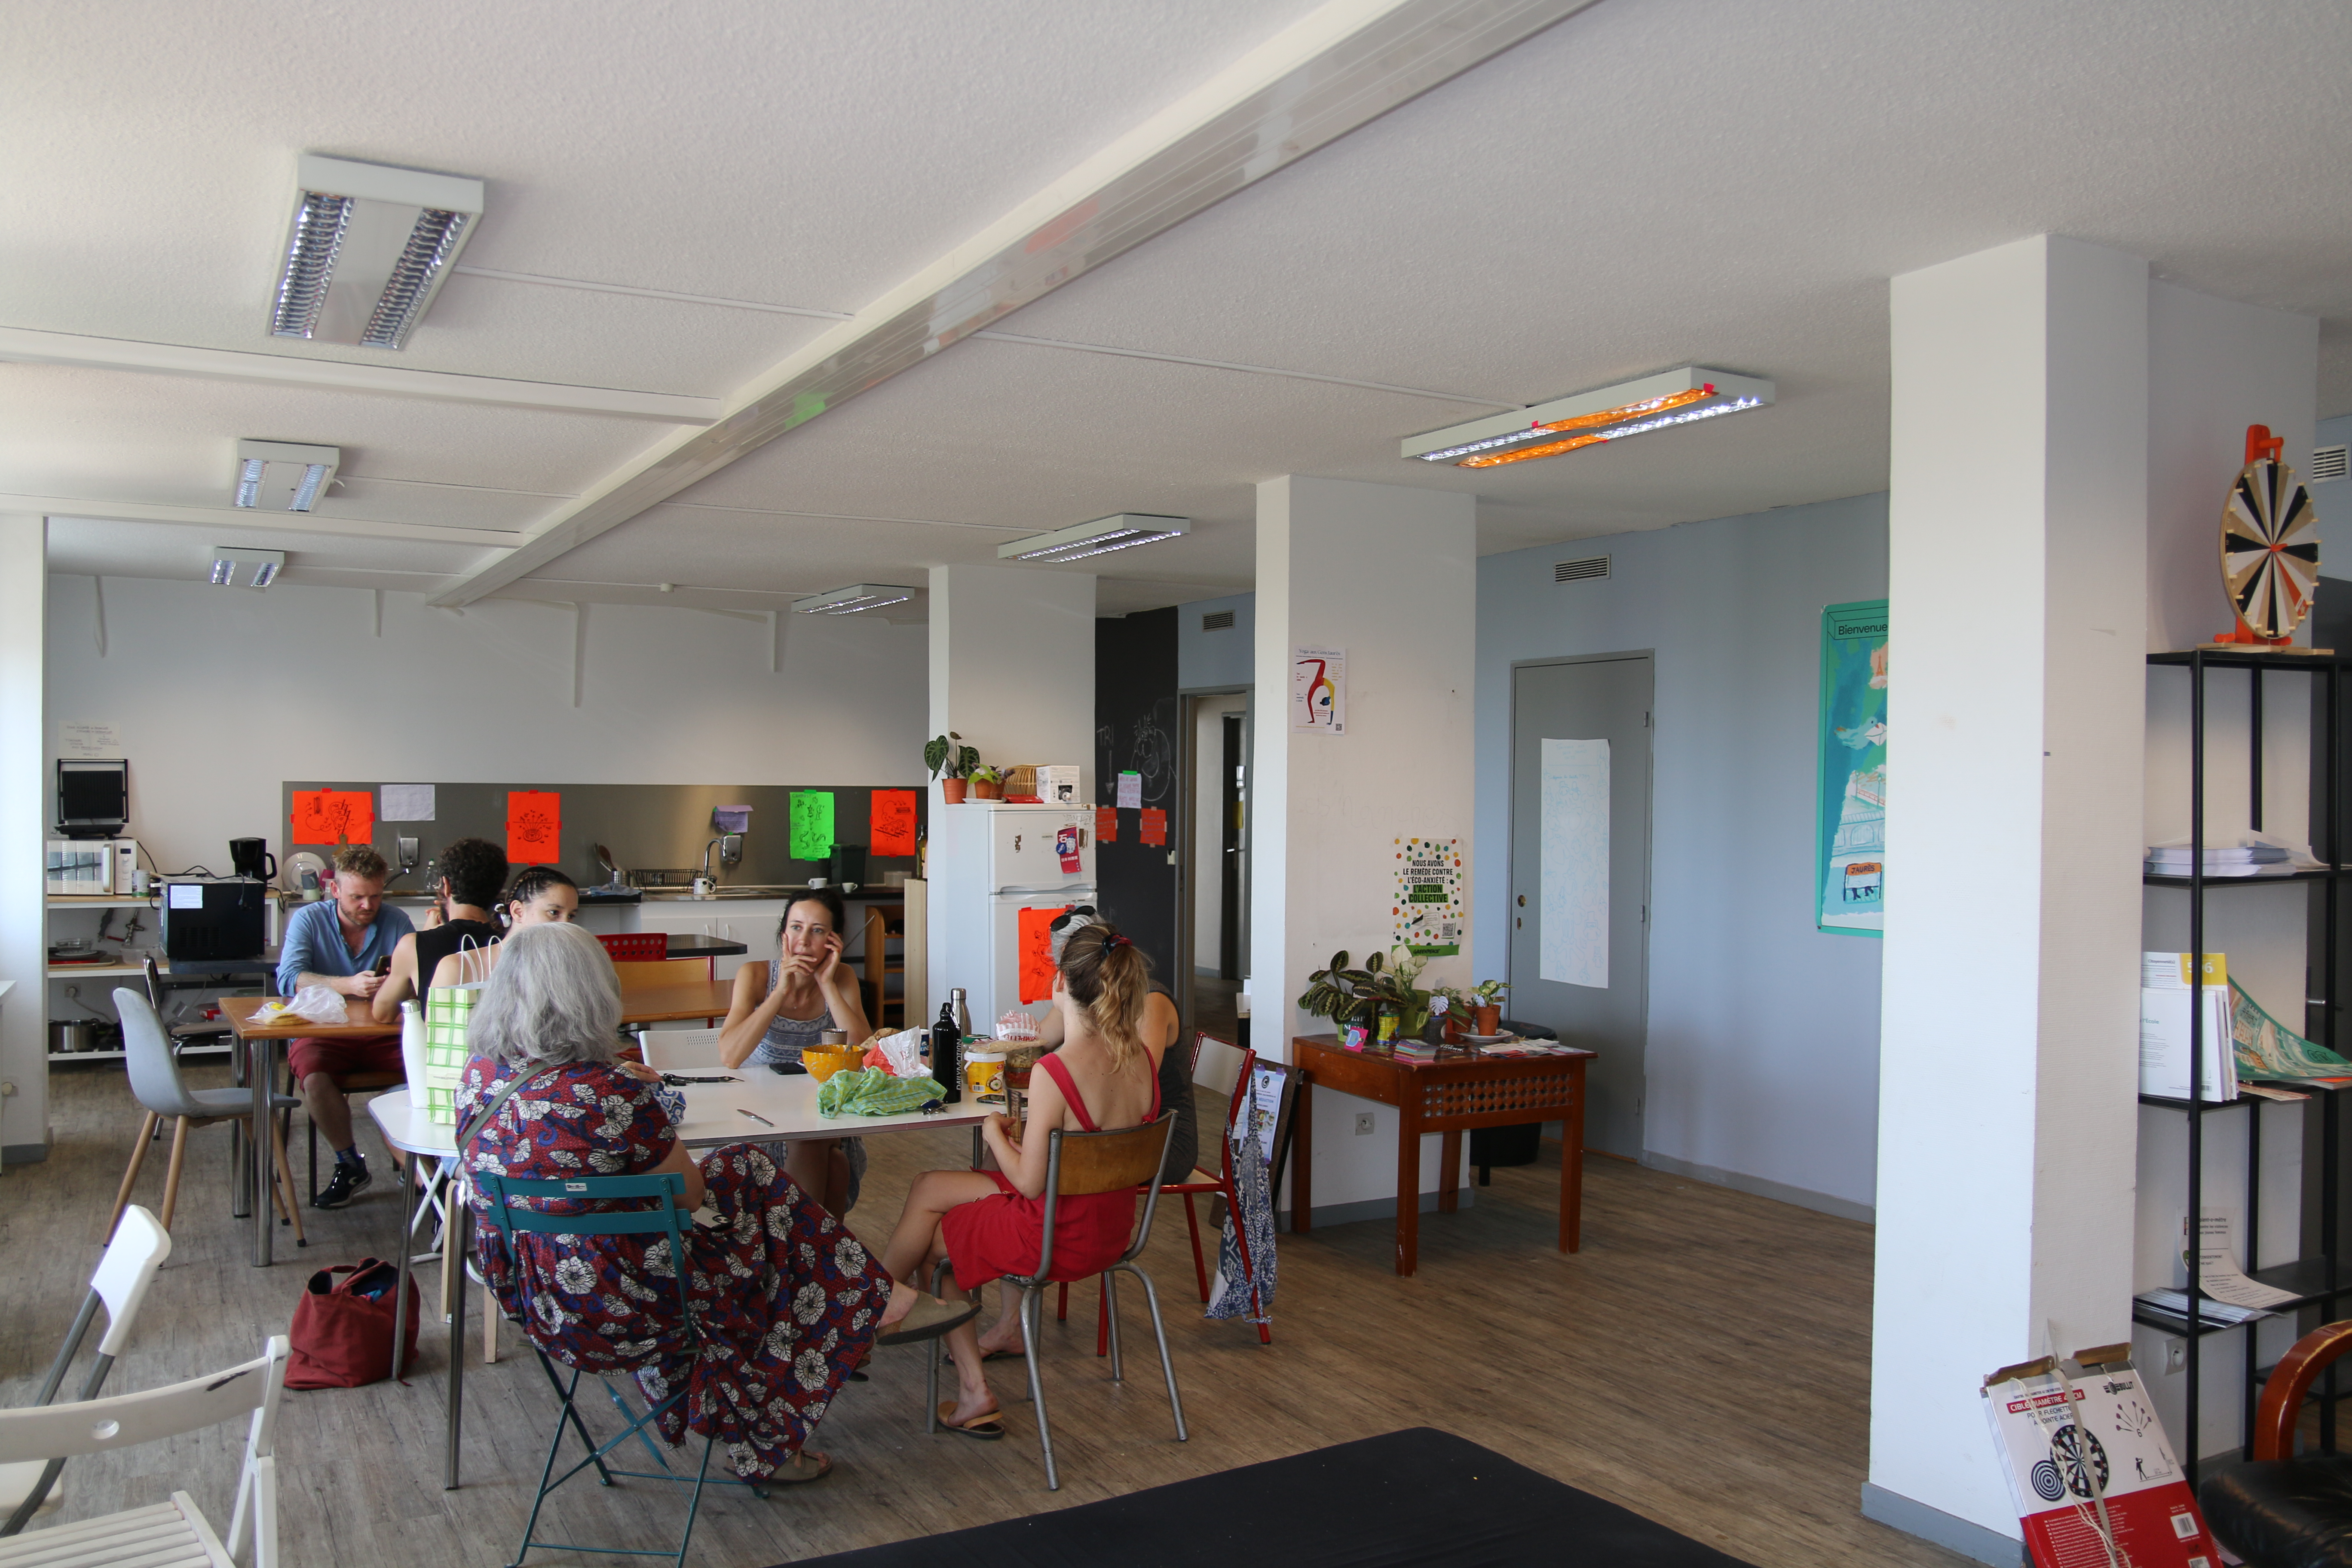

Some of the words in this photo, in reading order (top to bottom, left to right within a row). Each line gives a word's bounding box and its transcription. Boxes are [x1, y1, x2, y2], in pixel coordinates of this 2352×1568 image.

[1838, 624, 1888, 635] Bienvenue
[1096, 723, 1114, 746] TRI
[1851, 864, 1875, 873] JAURÈS
[1413, 885, 1442, 893] L'ACTION
[1409, 894, 1448, 903] COLLECTIVE
[2187, 962, 2213, 974] 56
[2119, 1381, 2134, 1390] BULLIT
[2044, 1405, 2071, 1415] FLÉCHETTE
[2136, 1428, 2142, 1437] 6
